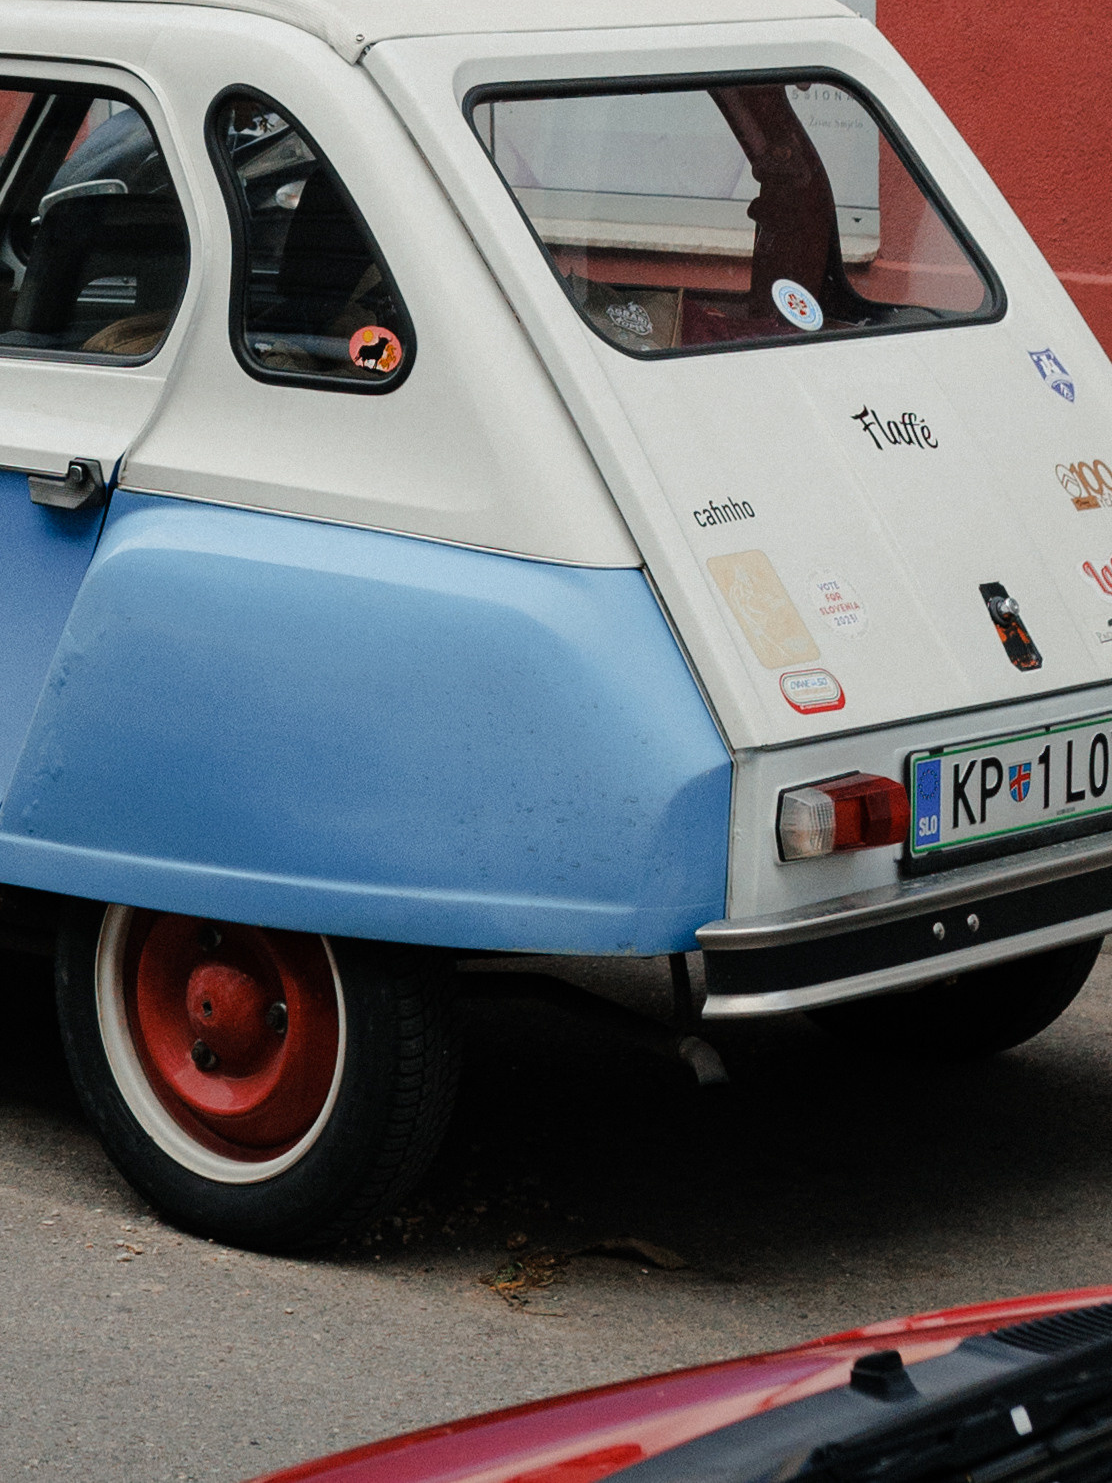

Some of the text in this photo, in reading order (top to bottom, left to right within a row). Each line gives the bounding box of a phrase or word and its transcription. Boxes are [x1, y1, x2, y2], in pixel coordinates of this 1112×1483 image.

[816, 580, 840, 591] VOTE
[825, 592, 843, 602] FOR
[819, 601, 860, 616] SLOVENIA
[952, 731, 1112, 830] KP 1LO
[918, 815, 938, 838] SLO
